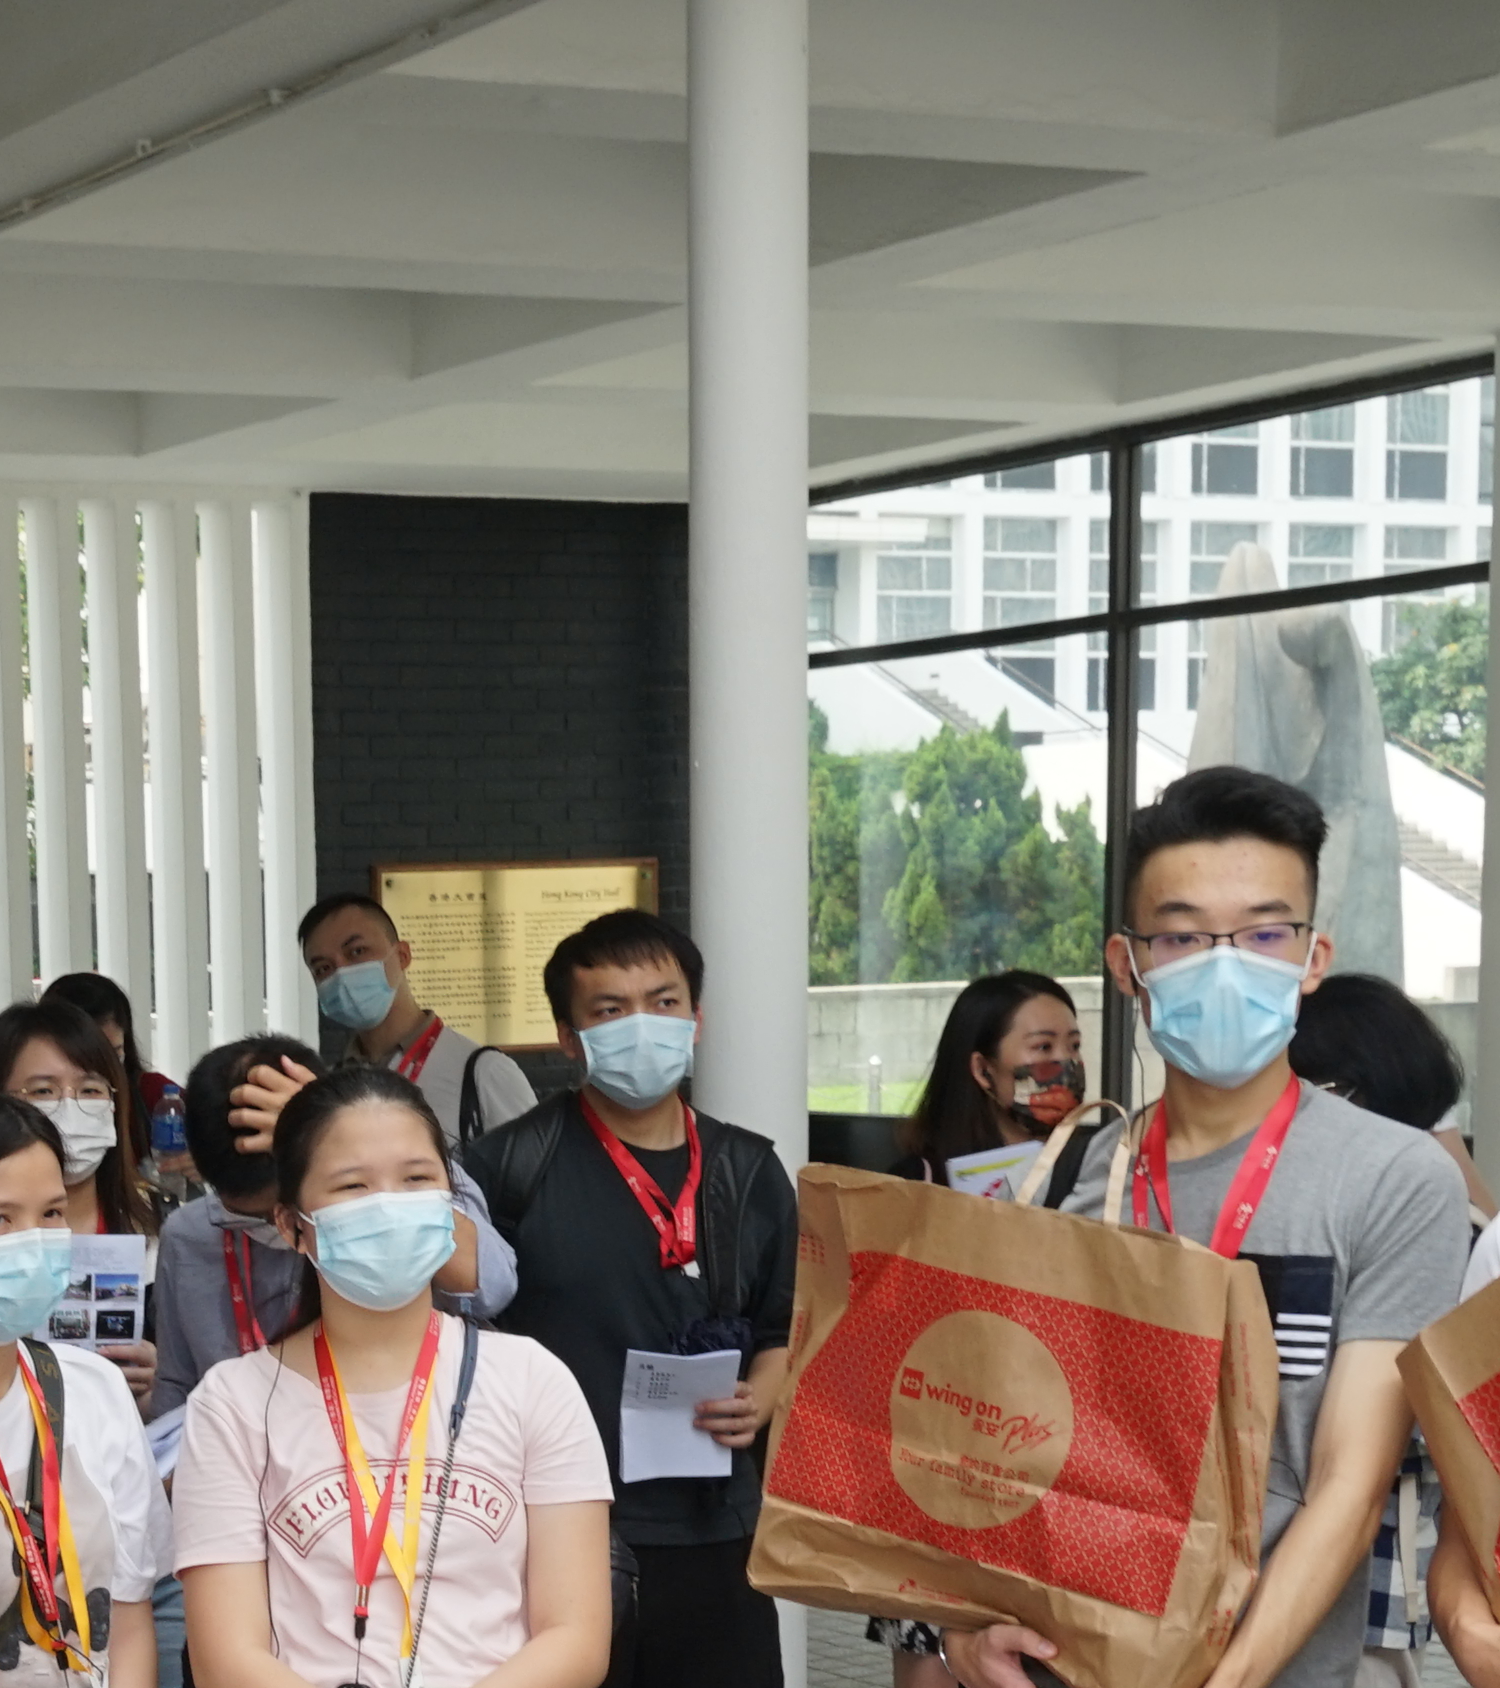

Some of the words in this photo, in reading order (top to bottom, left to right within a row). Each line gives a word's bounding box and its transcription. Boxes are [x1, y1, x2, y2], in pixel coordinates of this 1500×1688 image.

[926, 1384, 973, 1417] wing
[976, 1401, 1002, 1421] on
[981, 1477, 1026, 1498] store
